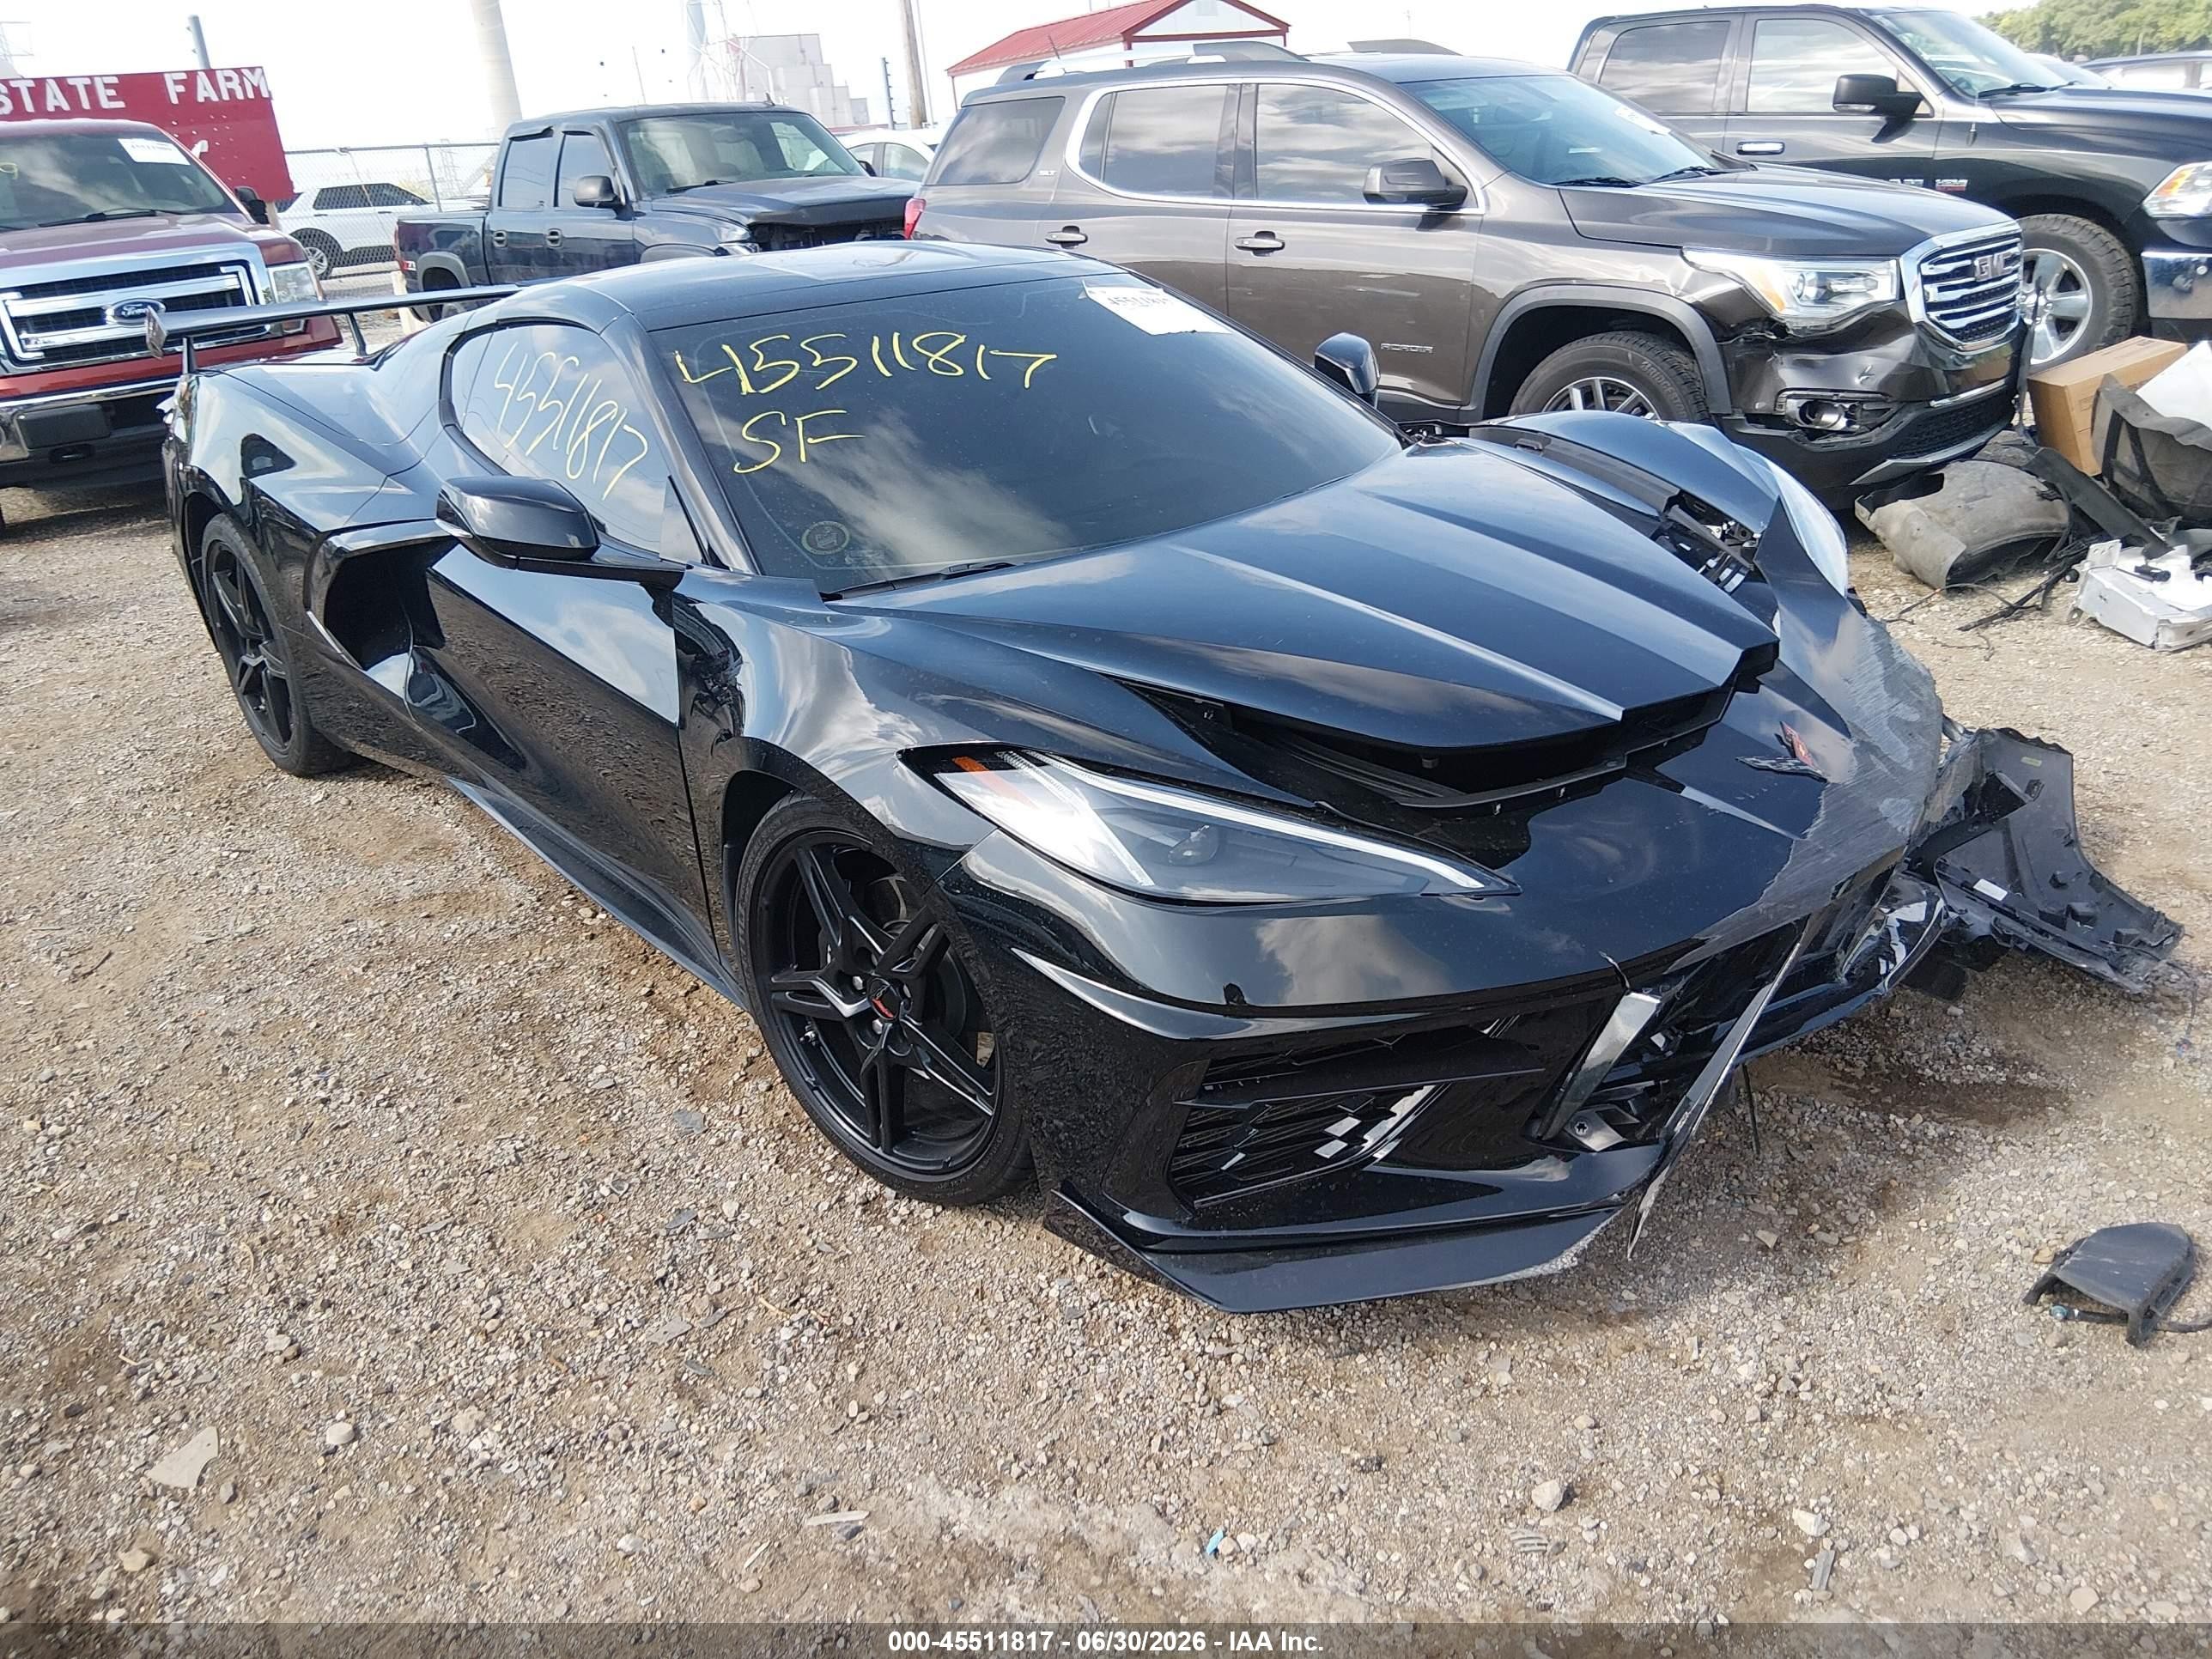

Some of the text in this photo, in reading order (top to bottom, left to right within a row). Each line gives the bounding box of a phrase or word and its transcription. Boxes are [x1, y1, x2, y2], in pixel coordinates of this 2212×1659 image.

[163, 68, 273, 105] FARM
[1974, 251, 2014, 282] GMC
[674, 331, 1057, 395] 45511817
[1380, 343, 1433, 353] ACADIA
[1639, 361, 1688, 418] BRIDGESTON
[494, 341, 648, 501] 45511817
[734, 410, 865, 473] SF
